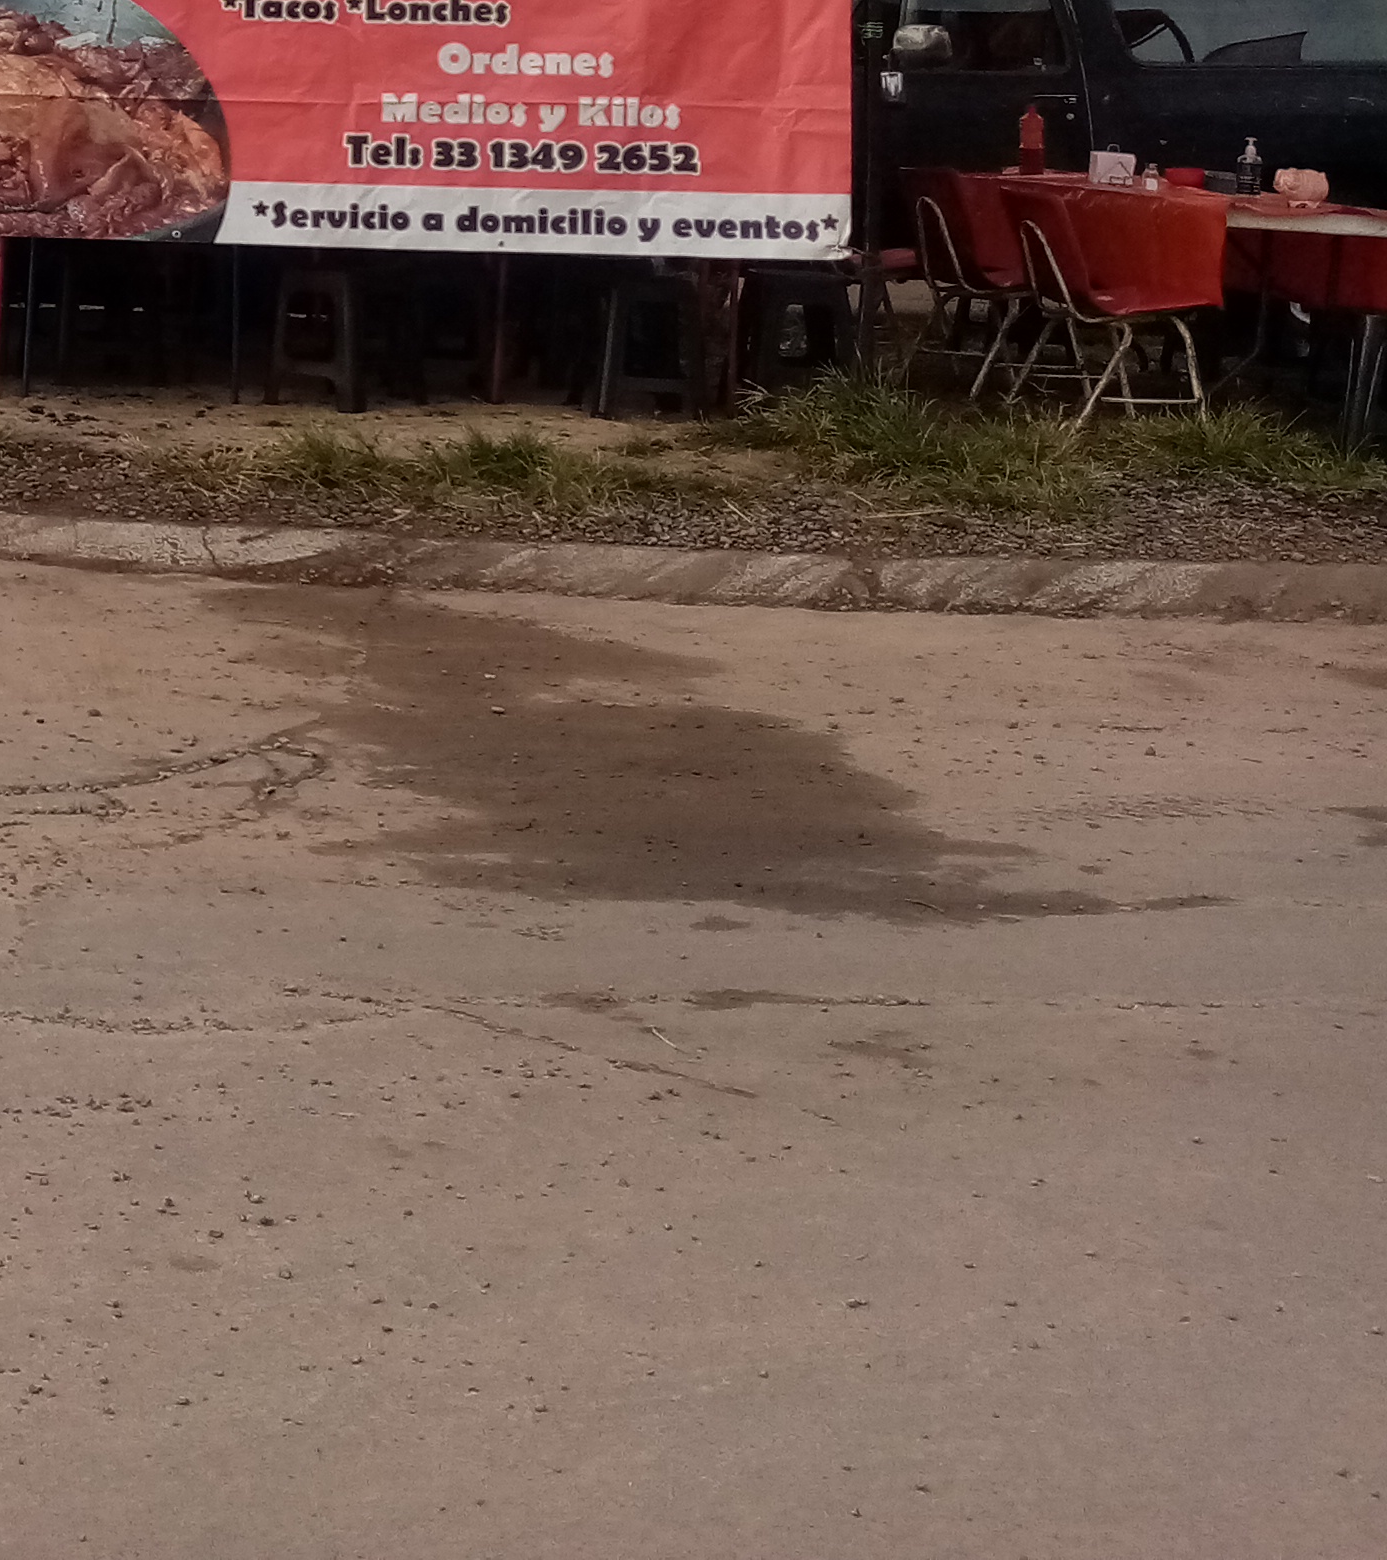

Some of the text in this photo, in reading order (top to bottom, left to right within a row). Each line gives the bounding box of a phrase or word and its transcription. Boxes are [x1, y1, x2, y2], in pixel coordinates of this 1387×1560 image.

[437, 42, 615, 79] Ordenes
[381, 92, 681, 132] Medios y Kilos
[344, 132, 701, 176] Tel: 33 1349 2652
[422, 211, 444, 232] a
[455, 205, 628, 237] domicilio
[637, 217, 661, 243] y
